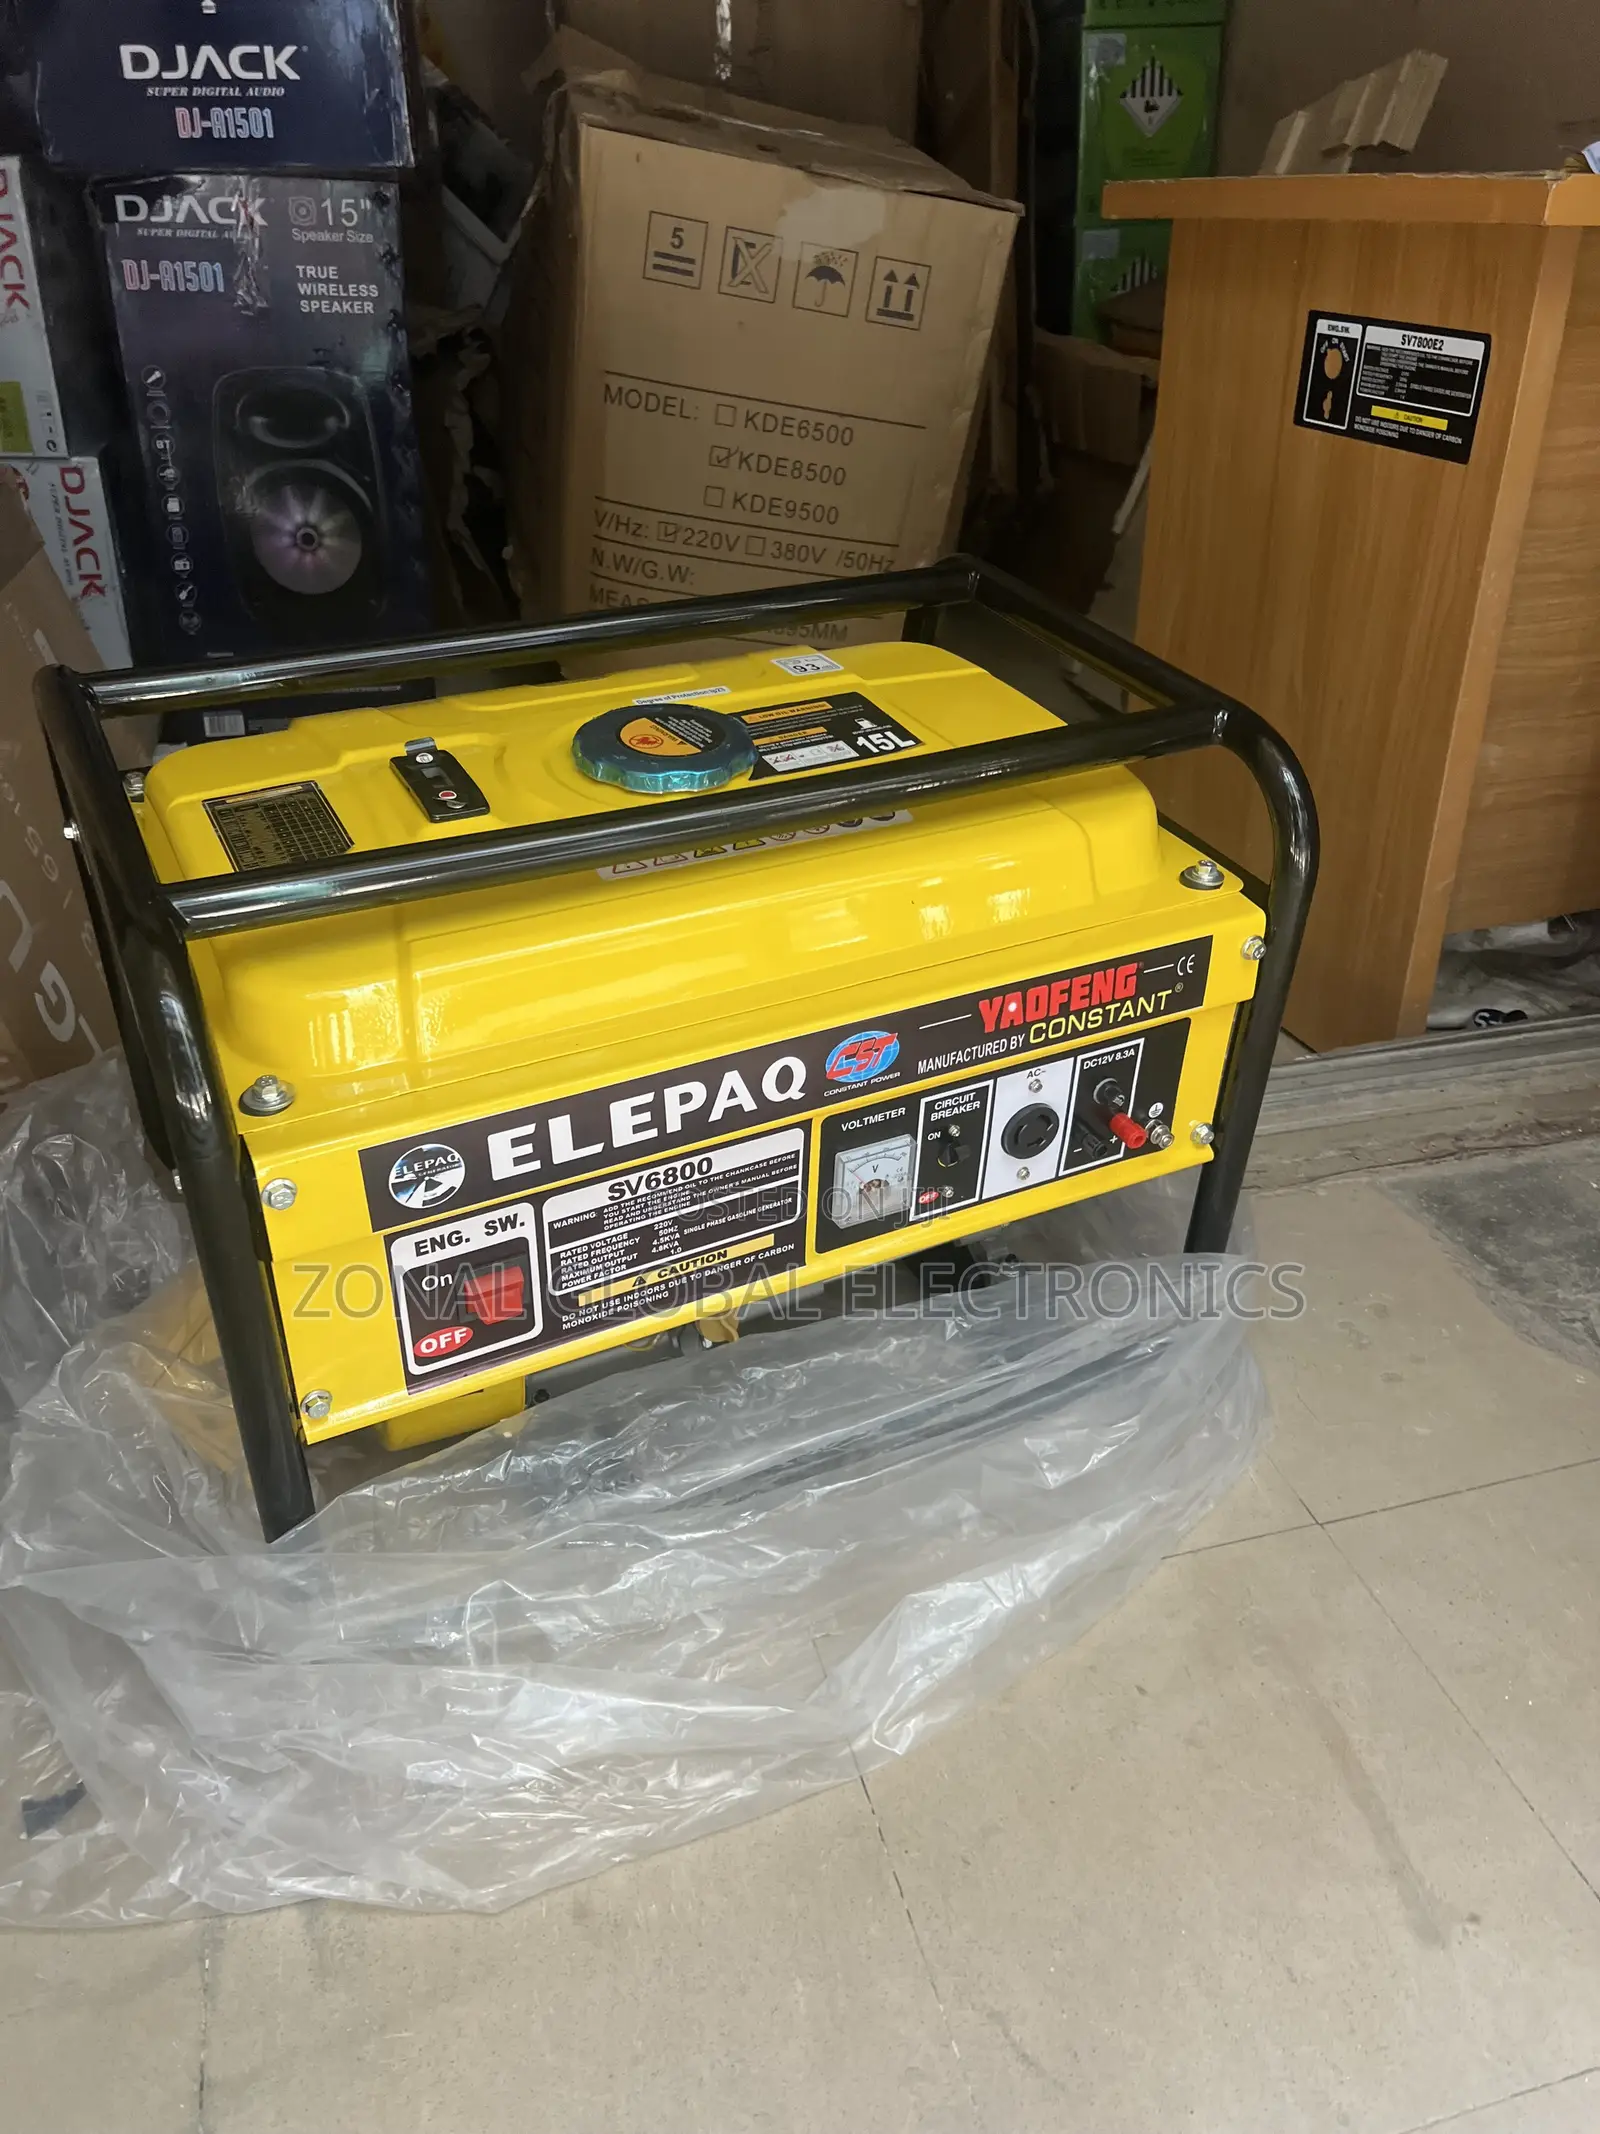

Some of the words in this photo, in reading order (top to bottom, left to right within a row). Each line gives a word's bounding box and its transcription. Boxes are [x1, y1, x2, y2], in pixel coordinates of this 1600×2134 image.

[119, 45, 300, 80] DJACK
[147, 86, 188, 97] SUPER
[192, 86, 242, 97] DIGITAL
[246, 86, 285, 98] AUDIO
[175, 107, 274, 139] DJ-A1501
[137, 228, 172, 238] SUPER
[176, 228, 218, 238] DIGITAL
[291, 228, 344, 242] Speaker
[346, 230, 374, 244] Size
[122, 259, 225, 292] DJ-A1501
[296, 265, 338, 280] TRUE
[298, 282, 378, 298] WIRELESS
[300, 300, 375, 314] SPEAKER
[1401, 334, 1445, 352] SV7800E2
[604, 384, 699, 420] MODEL:
[744, 409, 854, 446] KDE6500
[738, 450, 846, 486] KDE8500
[732, 492, 839, 526] KDE9500
[60, 465, 106, 598] DJACK
[594, 509, 649, 539] V/Hz:
[683, 527, 740, 552] 220V
[770, 540, 826, 565] 380V
[856, 730, 917, 754] 15L
[978, 962, 1138, 1034] YAOFENG
[917, 1038, 1008, 1075] MANUFACTURED
[1010, 1033, 1026, 1052] BY
[1030, 988, 1172, 1044] CONSTANT
[1083, 1052, 1116, 1070] DC12V
[1116, 1048, 1136, 1062] 8.3A
[824, 1081, 869, 1098] CONSTANT
[870, 1071, 902, 1086] POWER
[930, 1100, 980, 1122] BREAKER
[934, 1092, 976, 1111] CIRCUIT
[487, 1056, 808, 1182] ELEPAQ
[840, 1108, 906, 1132] VOLTMETER
[927, 1130, 942, 1141] ON
[394, 1153, 460, 1176] ELEPAQ
[608, 1156, 713, 1202] SV6800
[603, 1204, 618, 1214] ADD
[620, 1200, 636, 1210] THE
[636, 1186, 683, 1204] RECOMMEND
[684, 1182, 696, 1191] OIL
[710, 1174, 724, 1182] THE
[768, 1153, 796, 1166] BEFORE
[604, 1214, 624, 1225] READ
[626, 1210, 641, 1220] AND
[642, 1195, 691, 1213] UNDERSTAND
[692, 1190, 706, 1198] THE
[708, 1180, 740, 1195] OWNER'S
[741, 1172, 770, 1185] MANUAL
[771, 1164, 798, 1176] BEFORE
[919, 1192, 938, 1204] OFF
[604, 1210, 620, 1220] YOU
[621, 1203, 645, 1214] START
[648, 1198, 662, 1206] THE
[664, 1190, 691, 1202] ENGINE
[604, 1215, 646, 1231] OPERATING
[648, 1210, 662, 1219] THE
[664, 1201, 691, 1214] ENGINE
[684, 1224, 706, 1235] SINGLE
[706, 1217, 726, 1228] PHASE
[727, 1207, 756, 1222] GASOLINE
[757, 1197, 793, 1213] GENERATOR
[414, 1230, 470, 1257] ENG.
[484, 1212, 526, 1237] SW.
[560, 1245, 588, 1259] RATED
[590, 1232, 629, 1249] VOLTAGE
[654, 1220, 674, 1230] 220V
[560, 1253, 590, 1267] RATED
[590, 1236, 640, 1259] FREQUENCY
[658, 1226, 679, 1236] 50HZ
[561, 1260, 590, 1275] RATED
[590, 1250, 626, 1265] OUTPUT
[652, 1232, 681, 1246] 4.5KVA
[561, 1265, 603, 1282] MAXIMUM
[604, 1253, 638, 1268] OUTPUT
[652, 1241, 680, 1254] 4.8KVA
[562, 1276, 594, 1290] POWER
[594, 1264, 628, 1279] FACTOR
[670, 1246, 682, 1255] 1.0
[656, 1250, 728, 1280] CAUTION
[420, 1273, 454, 1292] On
[562, 1312, 577, 1323] DO
[578, 1304, 599, 1318] NOT
[602, 1298, 622, 1310] USE
[623, 1282, 667, 1304] INDOORS
[668, 1276, 689, 1290] DUE
[690, 1272, 703, 1282] TO
[704, 1260, 742, 1278] DANGER
[744, 1254, 756, 1266] OF
[757, 1242, 795, 1260] CARBON
[562, 1309, 614, 1331] MONOXIDE
[616, 1290, 670, 1313] POISONING
[420, 1326, 468, 1354] OFF
